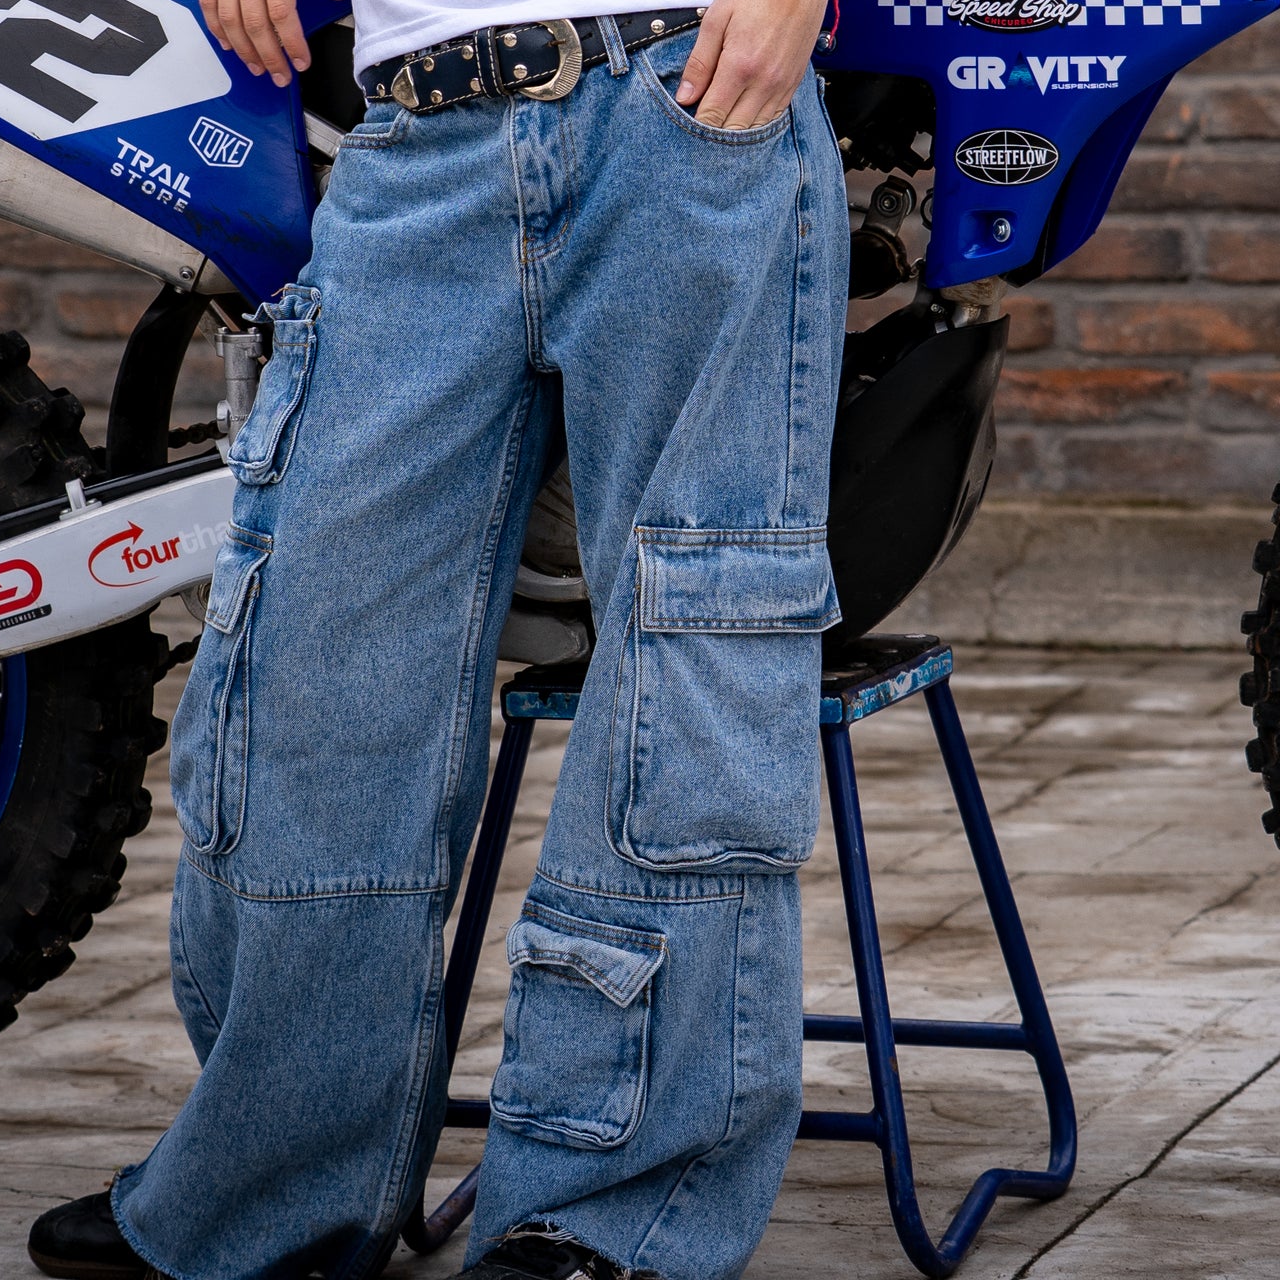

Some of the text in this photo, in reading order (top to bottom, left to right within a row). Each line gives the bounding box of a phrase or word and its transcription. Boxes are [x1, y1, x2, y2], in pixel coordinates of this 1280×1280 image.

[984, 16, 1033, 27] CHICUREO
[1051, 82, 1119, 90] SUSPENSIONS
[197, 121, 247, 164] TOKE
[965, 148, 1048, 165] STREETFLOW
[117, 136, 192, 199] TRAIL
[110, 162, 189, 213] STORE
